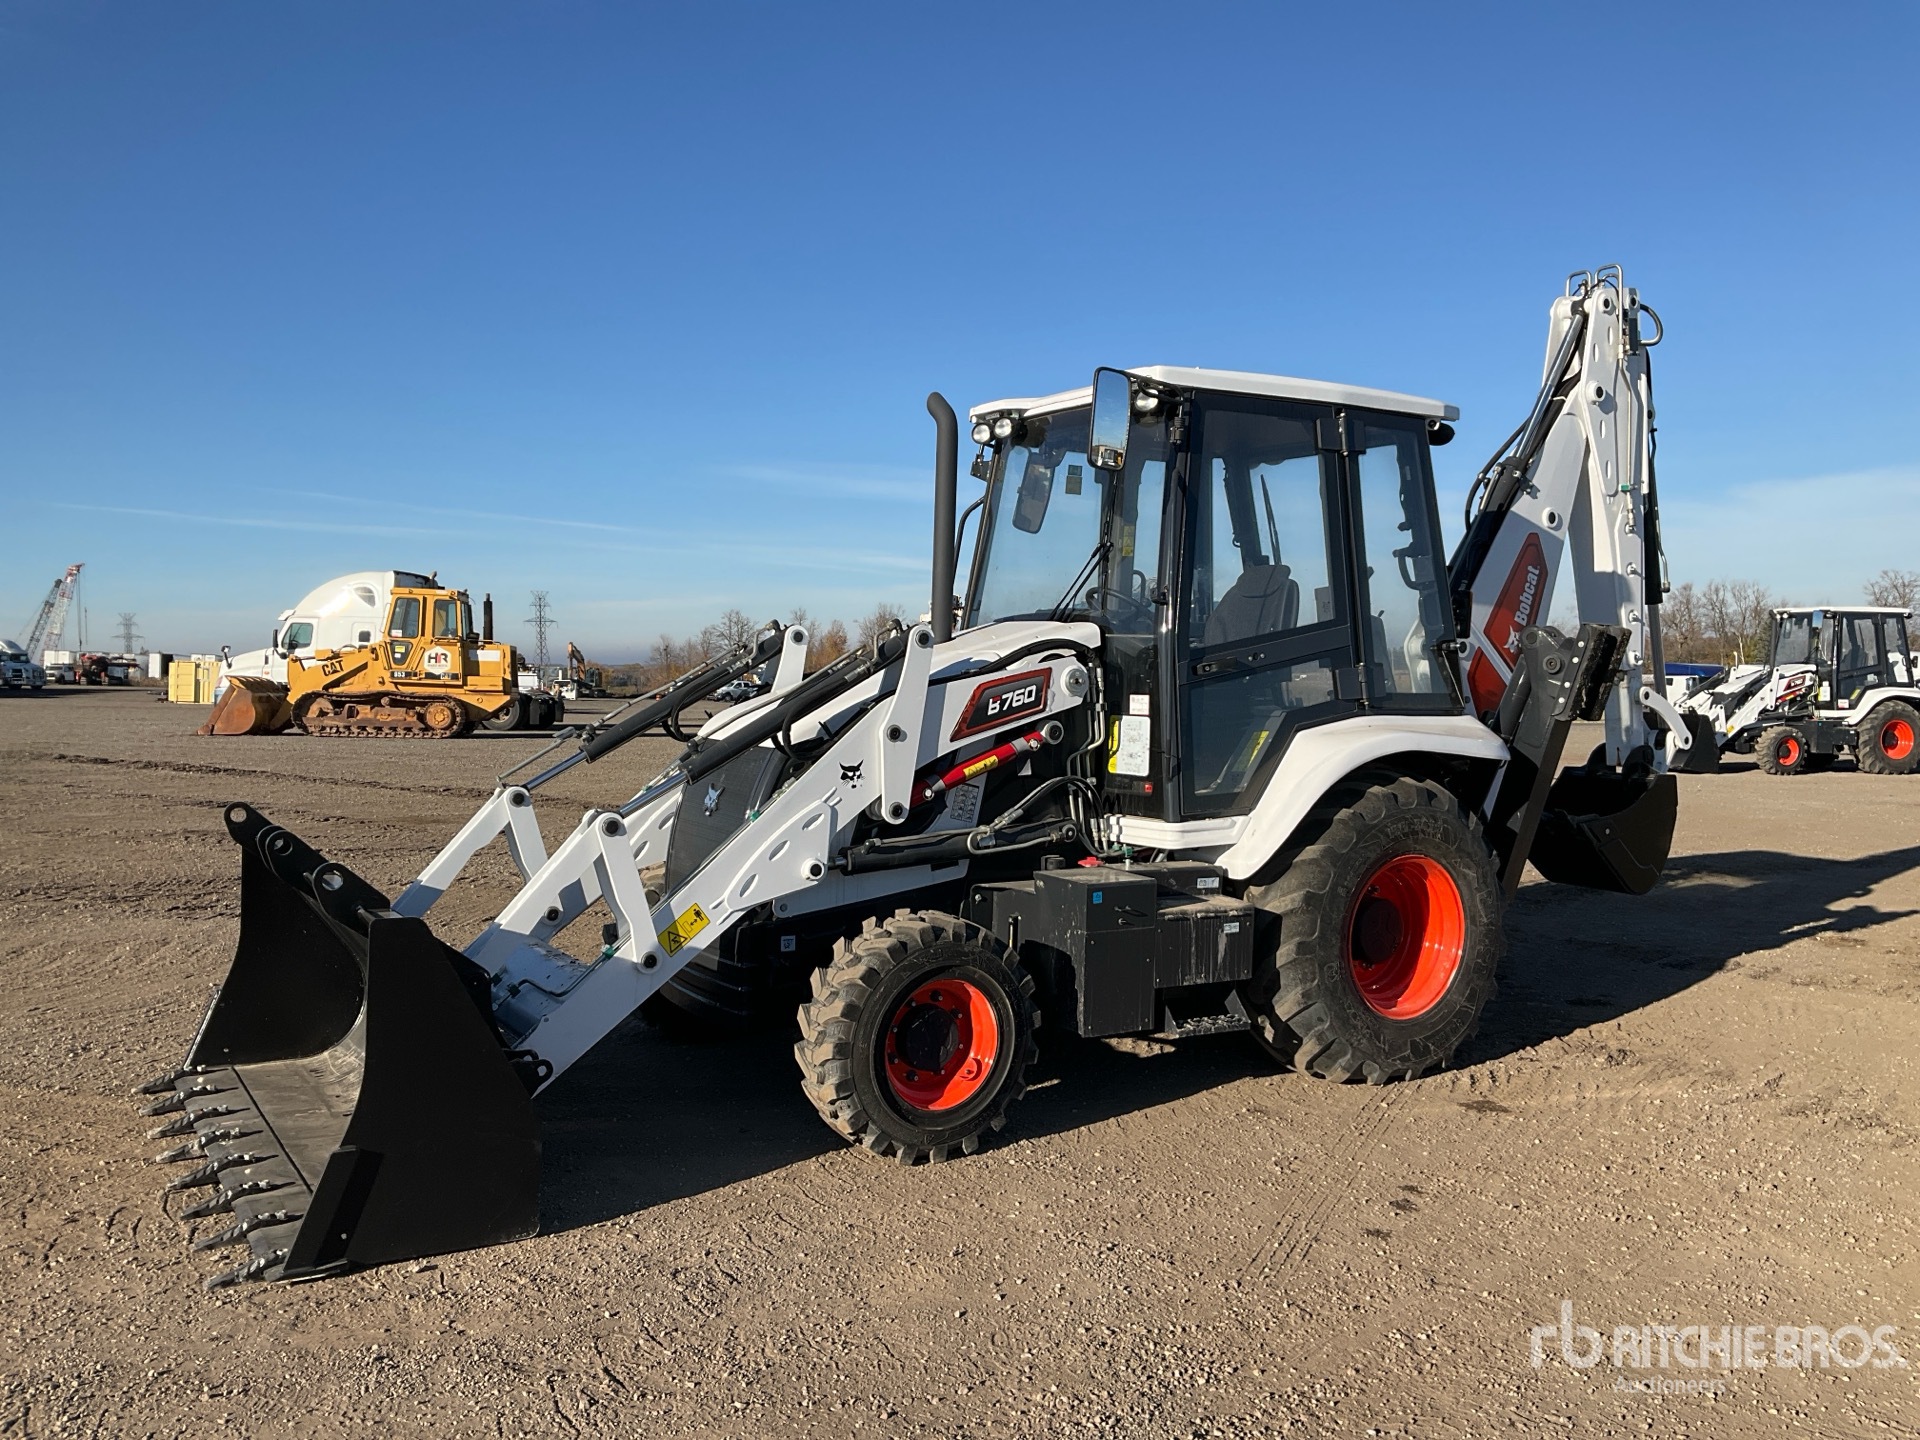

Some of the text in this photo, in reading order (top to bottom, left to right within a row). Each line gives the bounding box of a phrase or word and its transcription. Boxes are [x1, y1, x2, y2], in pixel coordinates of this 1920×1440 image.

[1514, 565, 1540, 626] Bobcat
[321, 659, 345, 677] CAT
[987, 684, 1037, 716] B760
